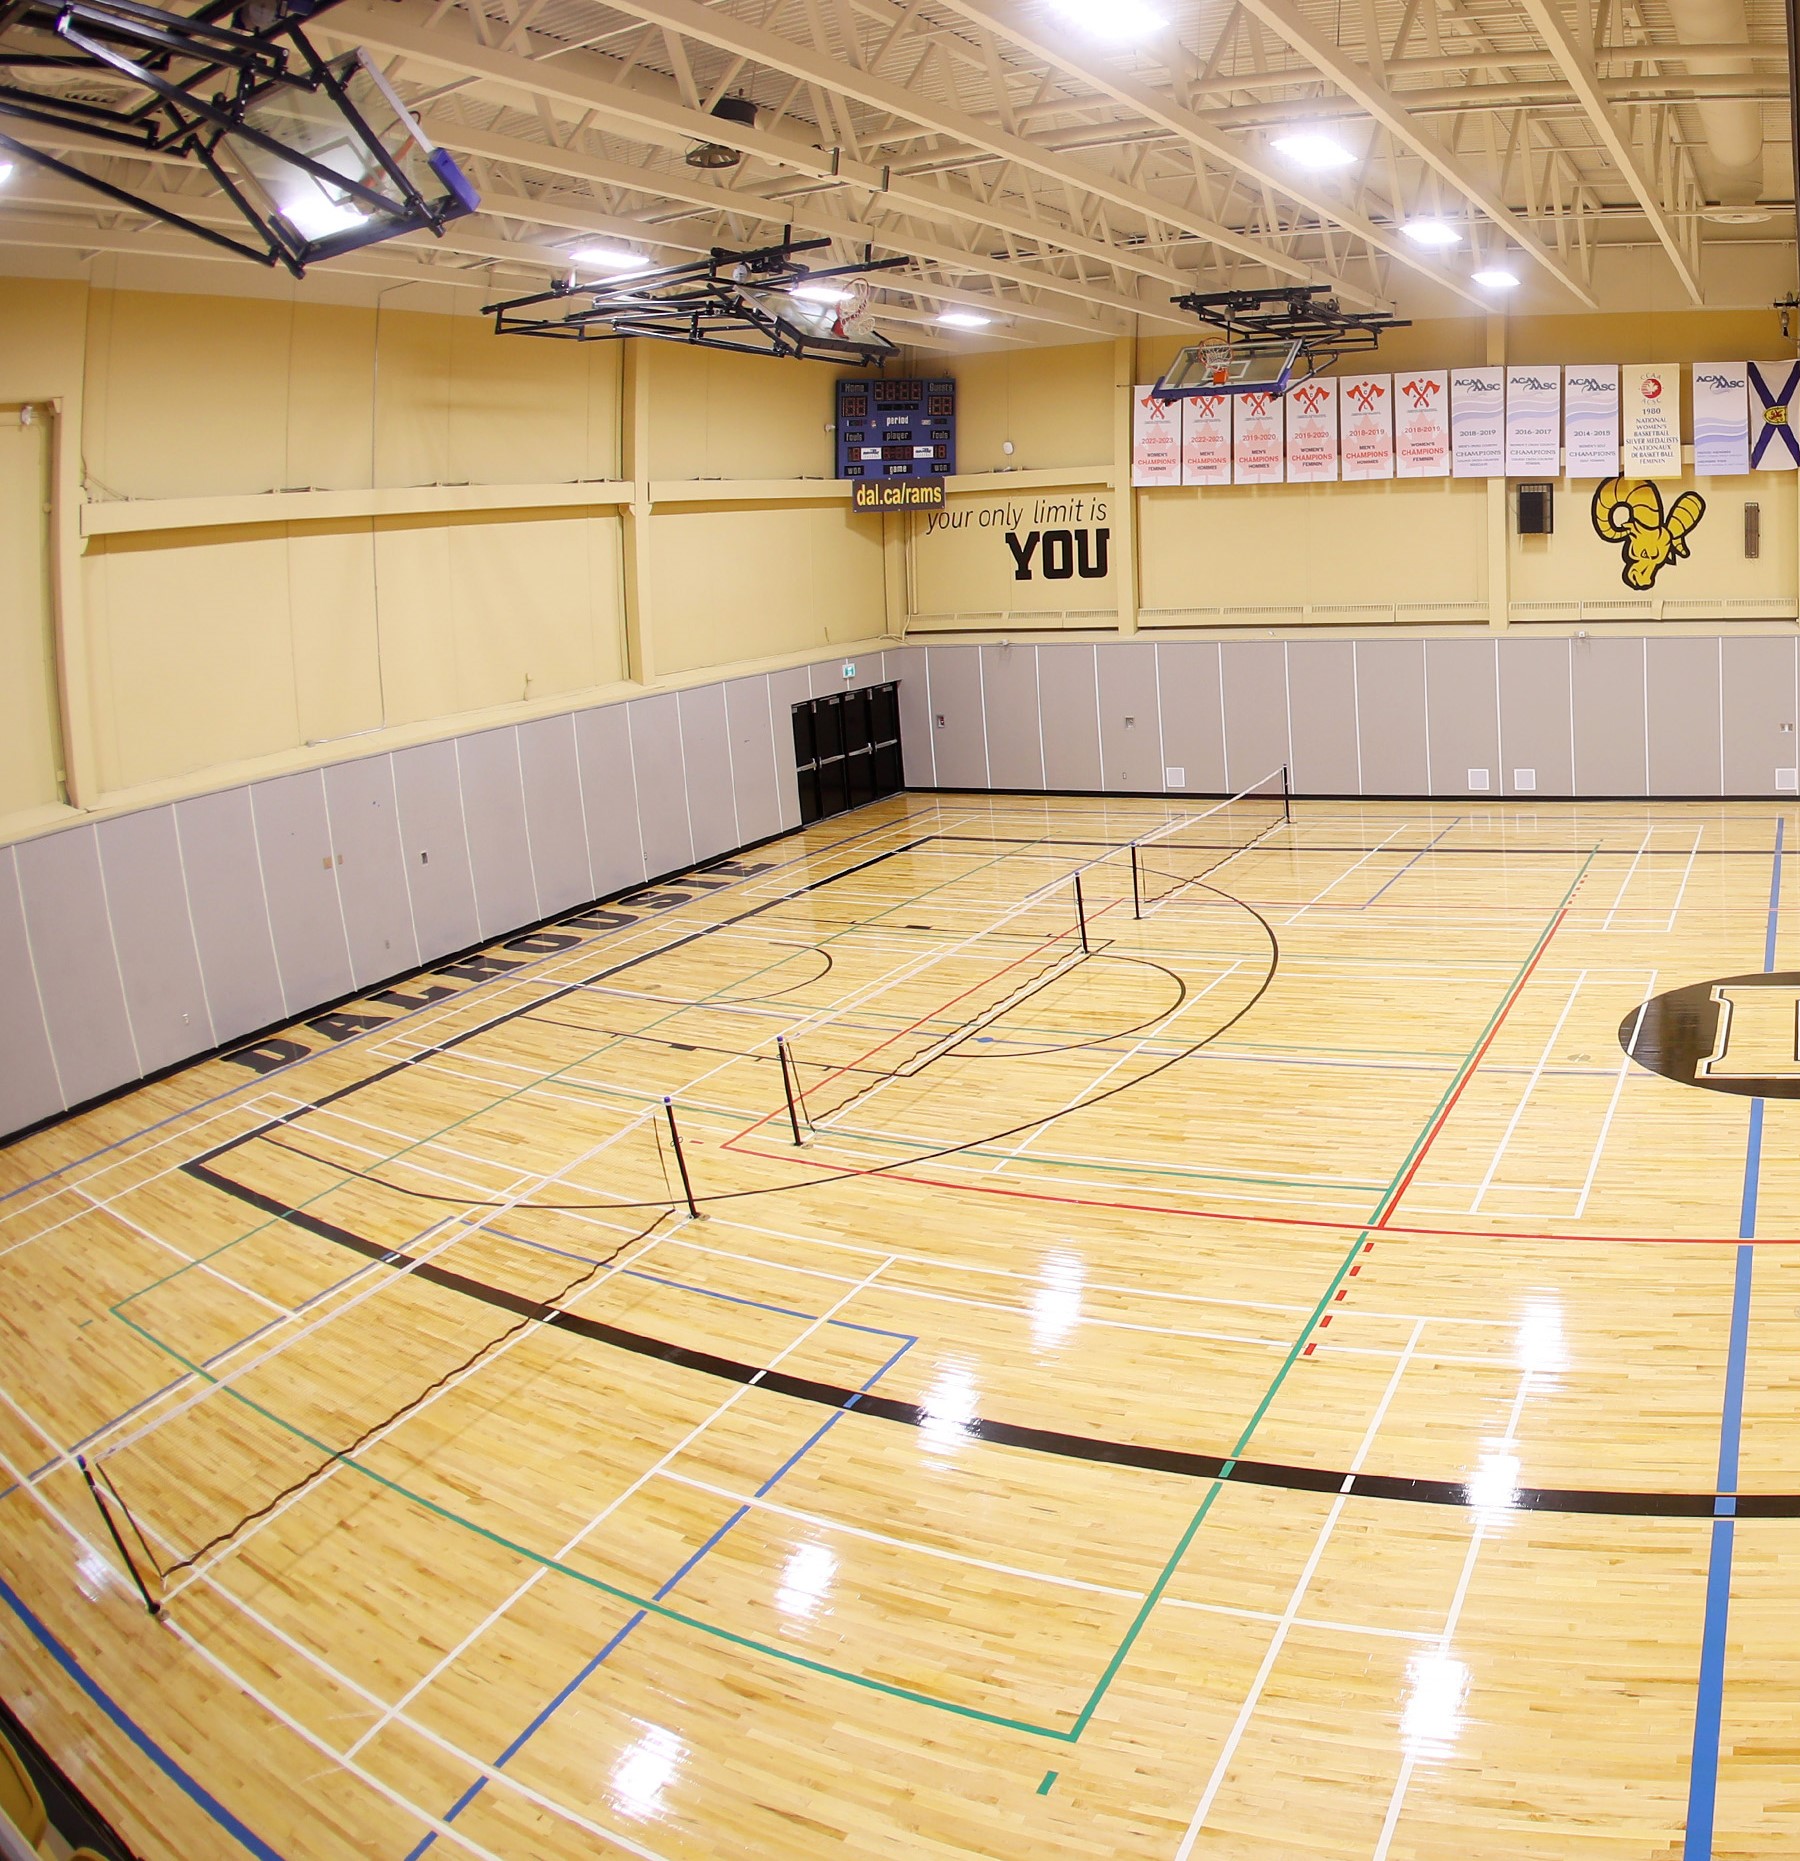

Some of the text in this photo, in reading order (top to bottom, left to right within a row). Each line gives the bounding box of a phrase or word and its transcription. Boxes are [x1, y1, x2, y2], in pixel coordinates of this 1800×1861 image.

[887, 416, 908, 426] period
[887, 432, 908, 440] player
[1402, 448, 1443, 456] CHAMPIONS
[890, 465, 907, 475] game
[857, 482, 941, 505] dal.ca/rams
[926, 497, 1107, 535] your only limit is
[1005, 528, 1110, 580] YOU
[220, 859, 780, 1075] DALHOUSIE
